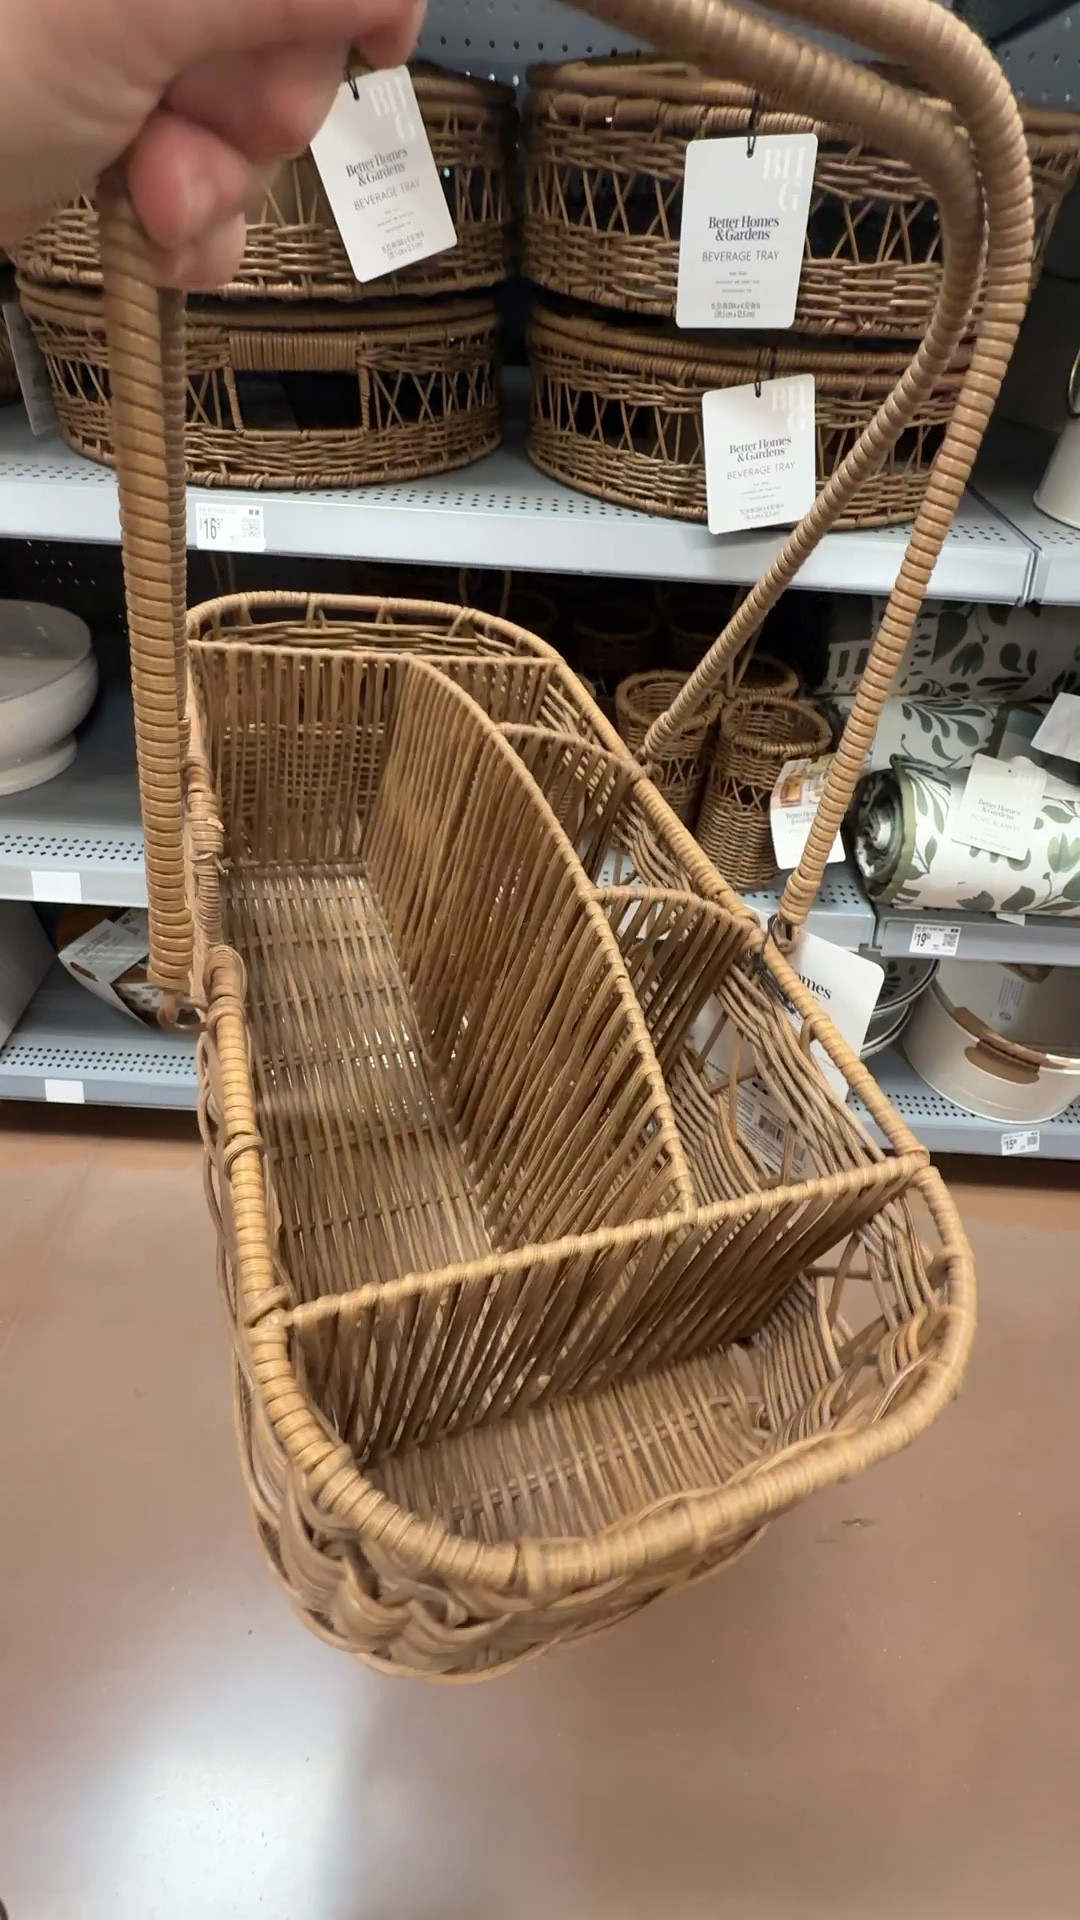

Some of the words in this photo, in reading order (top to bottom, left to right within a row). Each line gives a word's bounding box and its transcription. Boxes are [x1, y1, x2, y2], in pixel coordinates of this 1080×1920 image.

[345, 158, 374, 177] Better
[374, 147, 408, 167] Homes
[353, 185, 397, 212] BEVERAGE
[400, 177, 420, 193] TRAY
[708, 216, 741, 229] Better
[741, 215, 780, 228] Homes
[725, 227, 771, 241] Gardens
[702, 250, 752, 262] BEVERAGE
[756, 249, 779, 261] TRAY
[729, 442, 758, 455] Better
[758, 436, 792, 450] Homes
[745, 447, 786, 461] Gardens
[727, 464, 772, 480] BEVERAGE
[775, 461, 796, 473] TRAY
